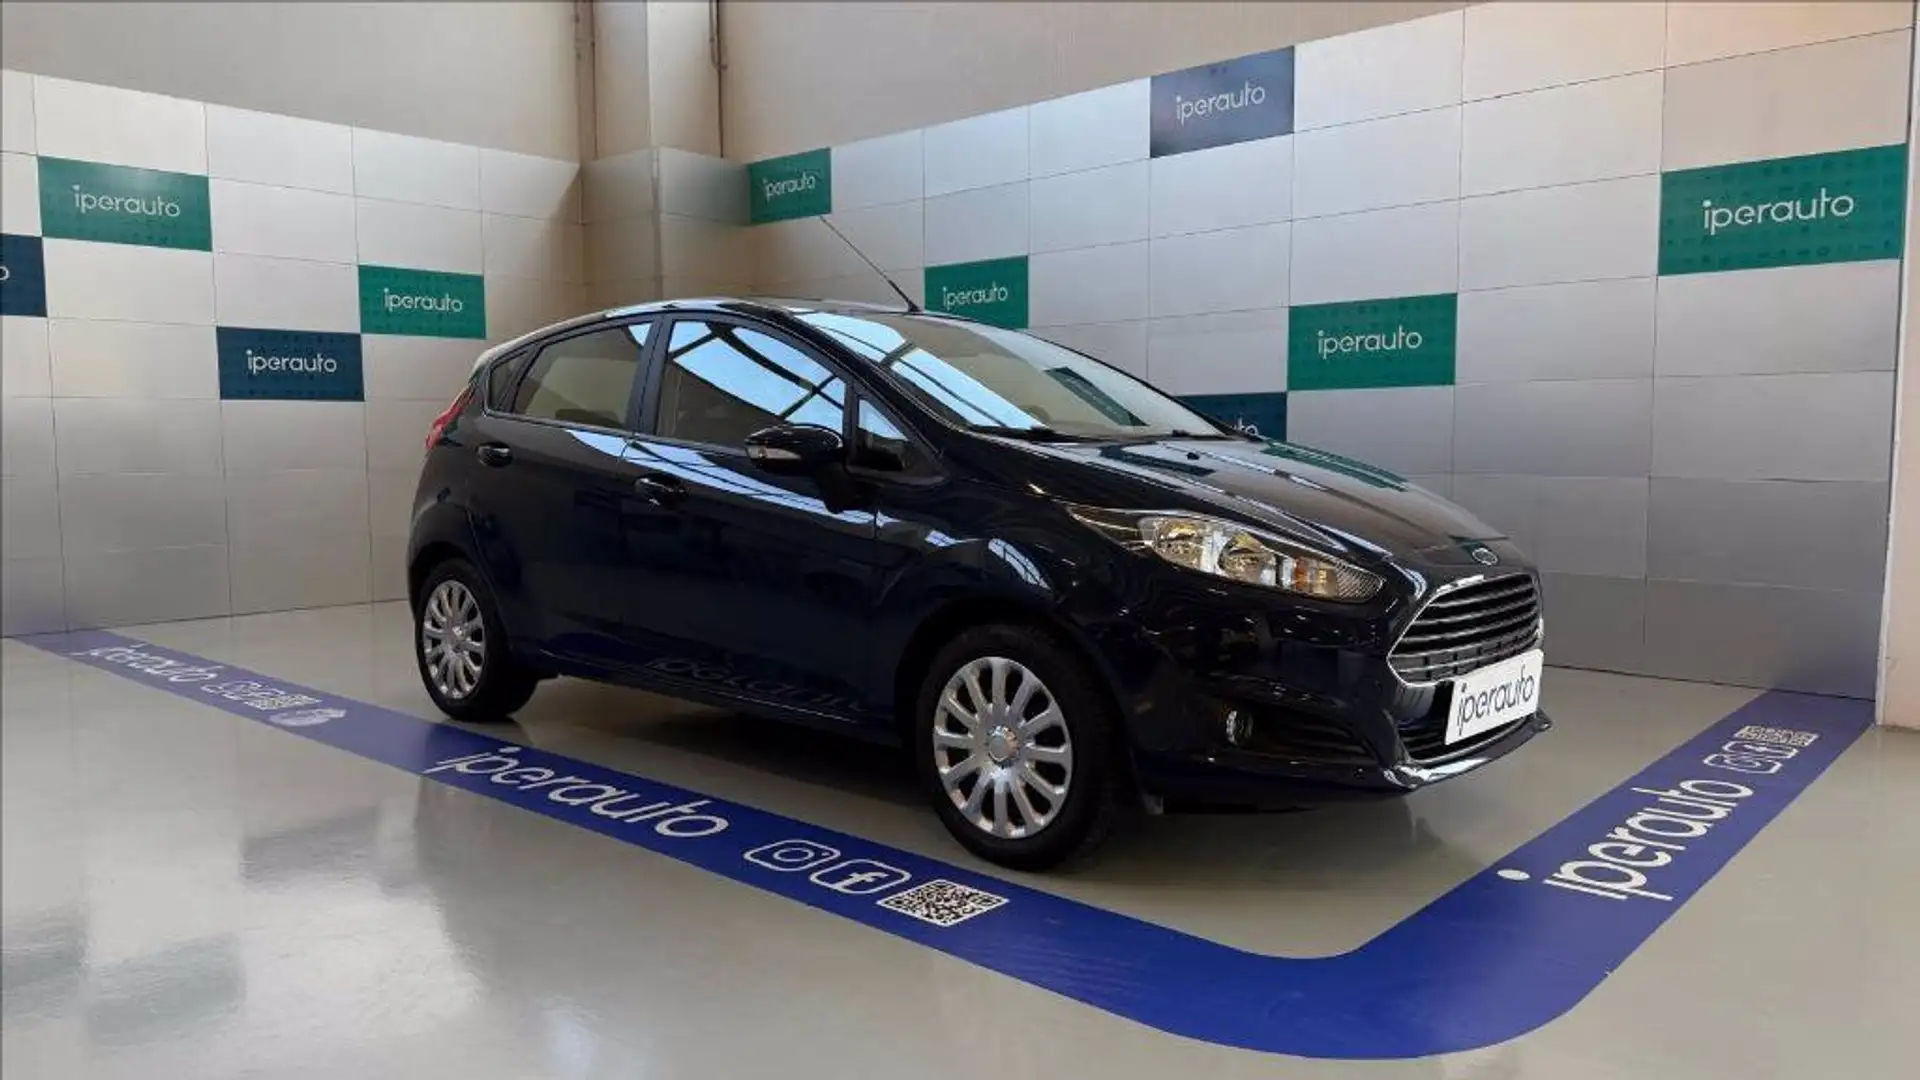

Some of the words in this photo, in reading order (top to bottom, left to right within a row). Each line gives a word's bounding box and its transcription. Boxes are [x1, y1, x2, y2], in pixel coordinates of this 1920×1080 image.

[1175, 81, 1266, 125] iperauto
[73, 184, 181, 218] iperauto
[762, 171, 815, 202] iperauto
[1702, 188, 1854, 235] iperauto
[383, 288, 464, 313] iperauto
[942, 281, 1008, 311] iperauto
[1317, 325, 1423, 360] iperauto
[246, 350, 338, 375] iperauto
[1457, 663, 1535, 737] iperauto
[423, 746, 729, 838] iperauto
[1497, 779, 1755, 902] iperauto
